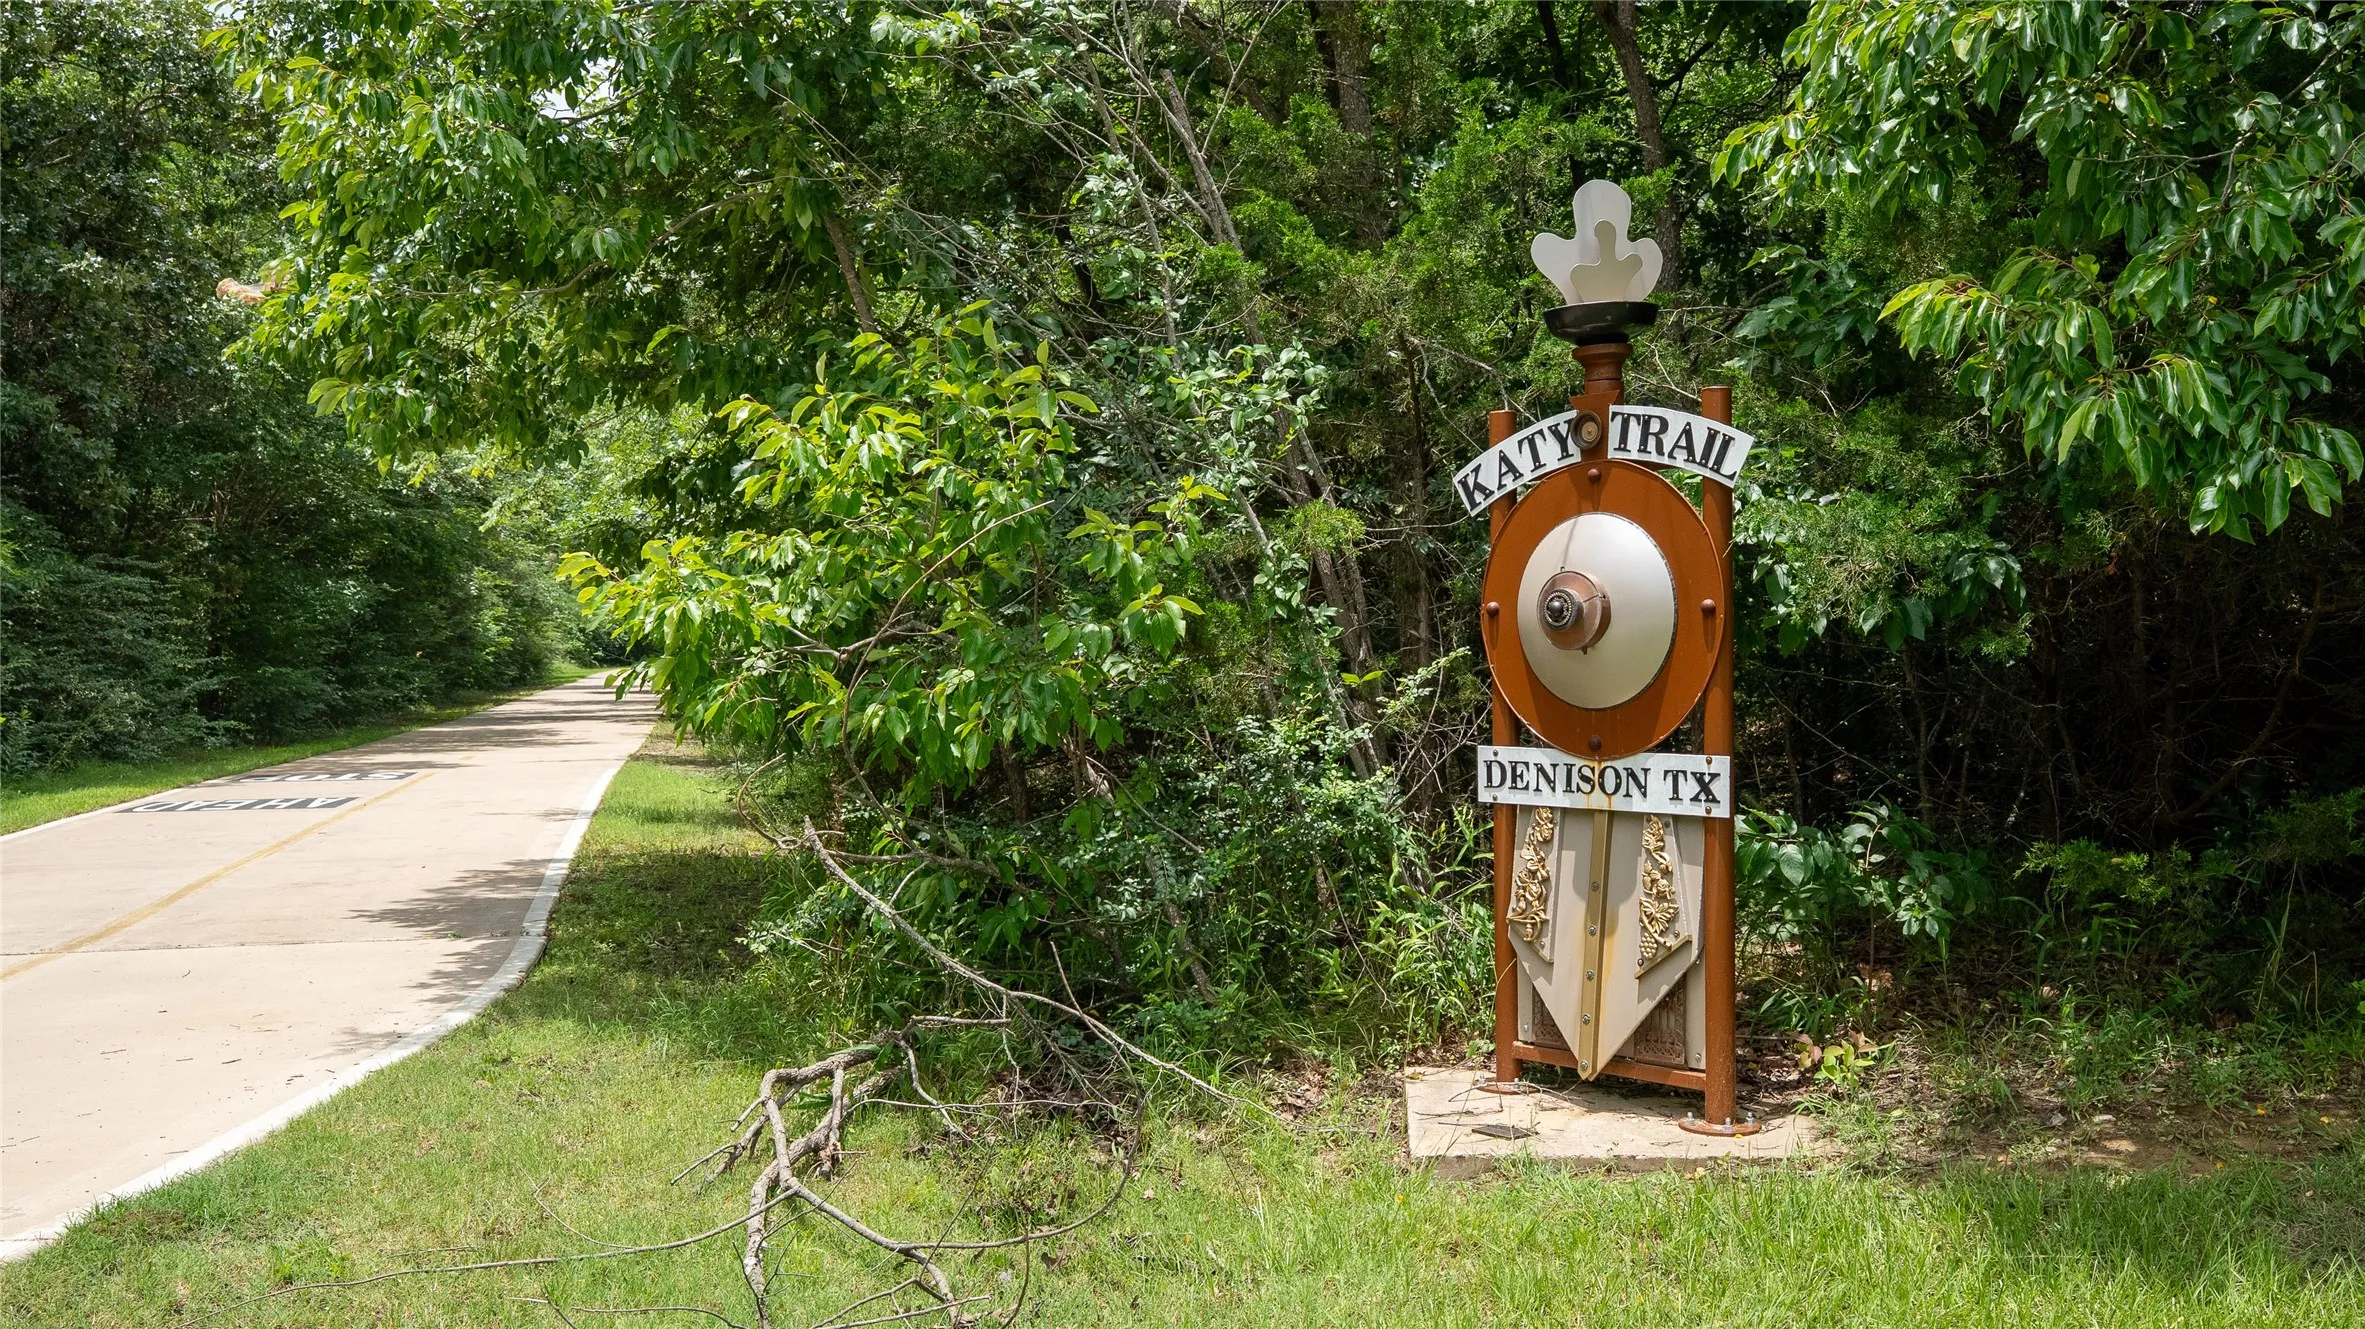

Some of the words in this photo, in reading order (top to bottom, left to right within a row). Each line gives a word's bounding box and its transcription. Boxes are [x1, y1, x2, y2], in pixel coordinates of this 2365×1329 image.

[1458, 417, 1575, 511] KATY
[1611, 411, 1737, 481] TRAIL
[239, 772, 408, 782] STOP
[1483, 760, 1651, 799] DENISON
[1663, 770, 1721, 803] TX
[132, 797, 346, 812] AHEAD
